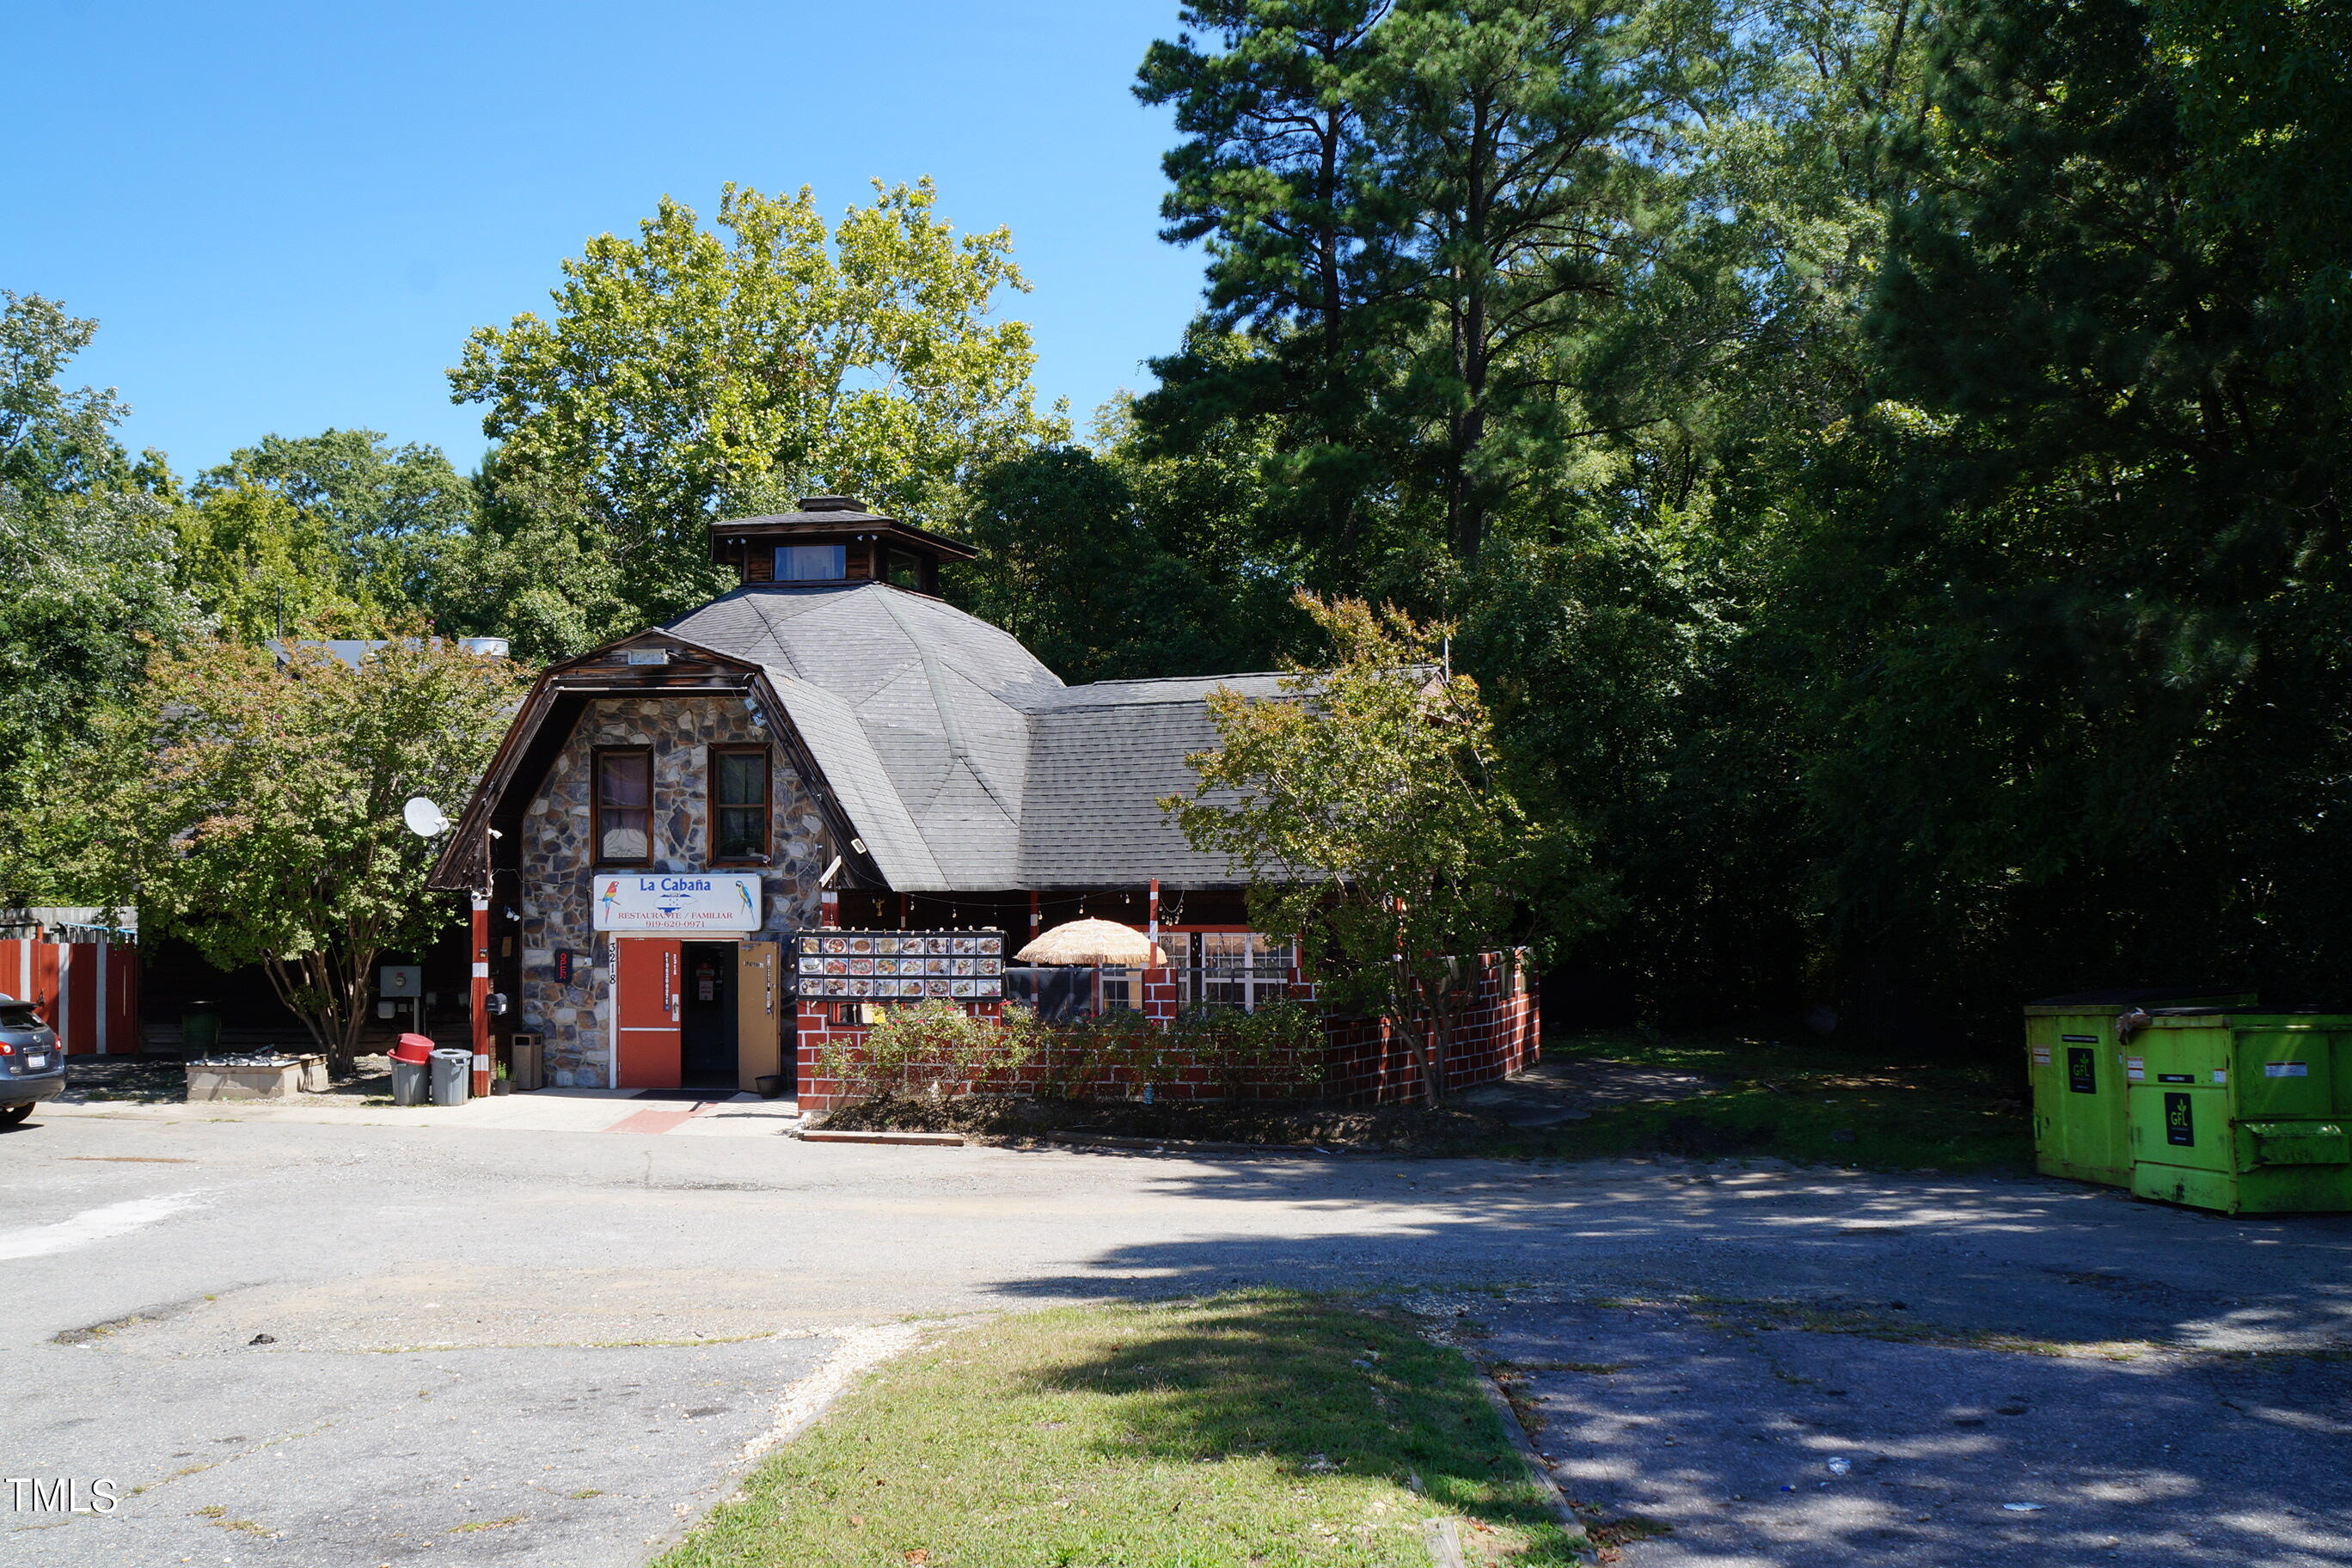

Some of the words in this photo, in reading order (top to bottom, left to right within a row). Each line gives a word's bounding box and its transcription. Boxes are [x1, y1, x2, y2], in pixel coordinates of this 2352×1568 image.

[640, 878, 655, 891] La
[661, 878, 711, 891] Cabaña
[2073, 1064, 2091, 1077] GFL
[2171, 1111, 2188, 1127] GFL
